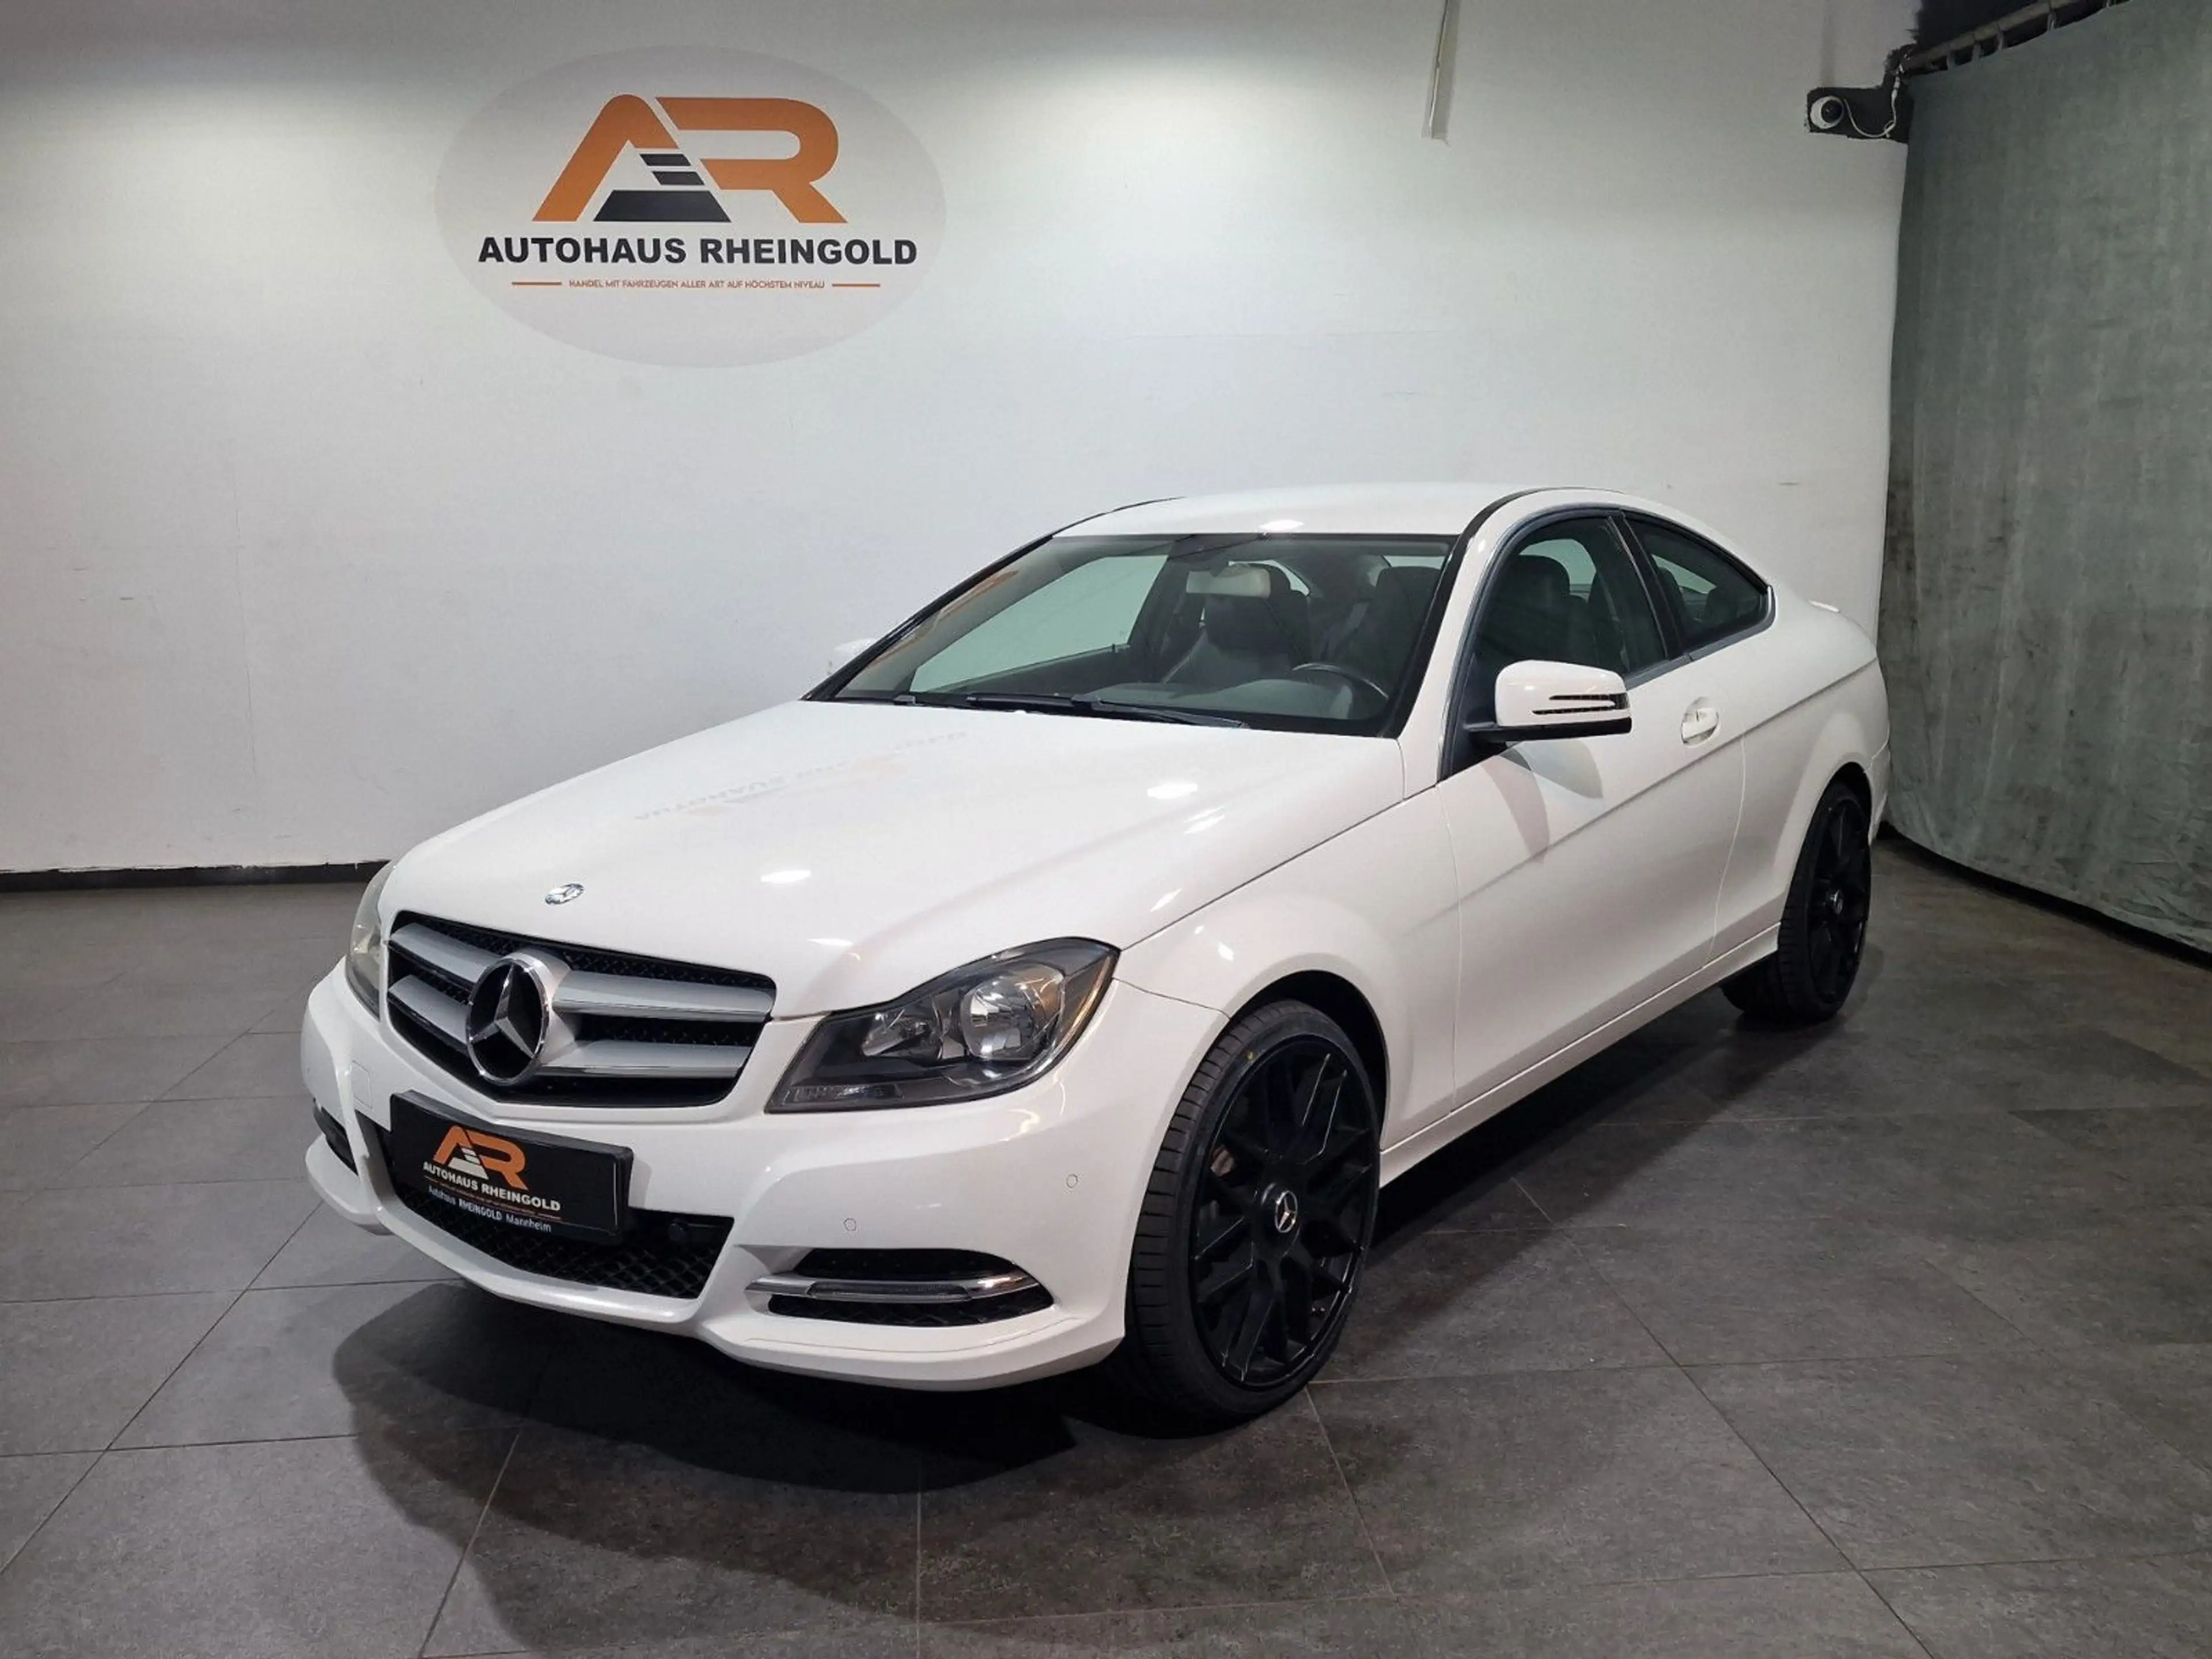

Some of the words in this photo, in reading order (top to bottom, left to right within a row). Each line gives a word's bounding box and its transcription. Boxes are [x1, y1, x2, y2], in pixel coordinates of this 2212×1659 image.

[478, 236, 687, 264] AUTOHAUS
[700, 238, 917, 265] RHEINGOLD
[569, 279, 603, 288] HANDEL
[605, 279, 620, 288] MIT
[622, 279, 678, 288] FAHRZEUGEN
[680, 279, 706, 289] ALLER
[708, 279, 724, 289] ART
[727, 279, 743, 289] AUF
[794, 280, 825, 289] NIVEAU
[423, 1161, 478, 1191] AUTOHAUS
[482, 1183, 561, 1211] RHEINGOLD
[505, 1213, 552, 1233] Mannheim
